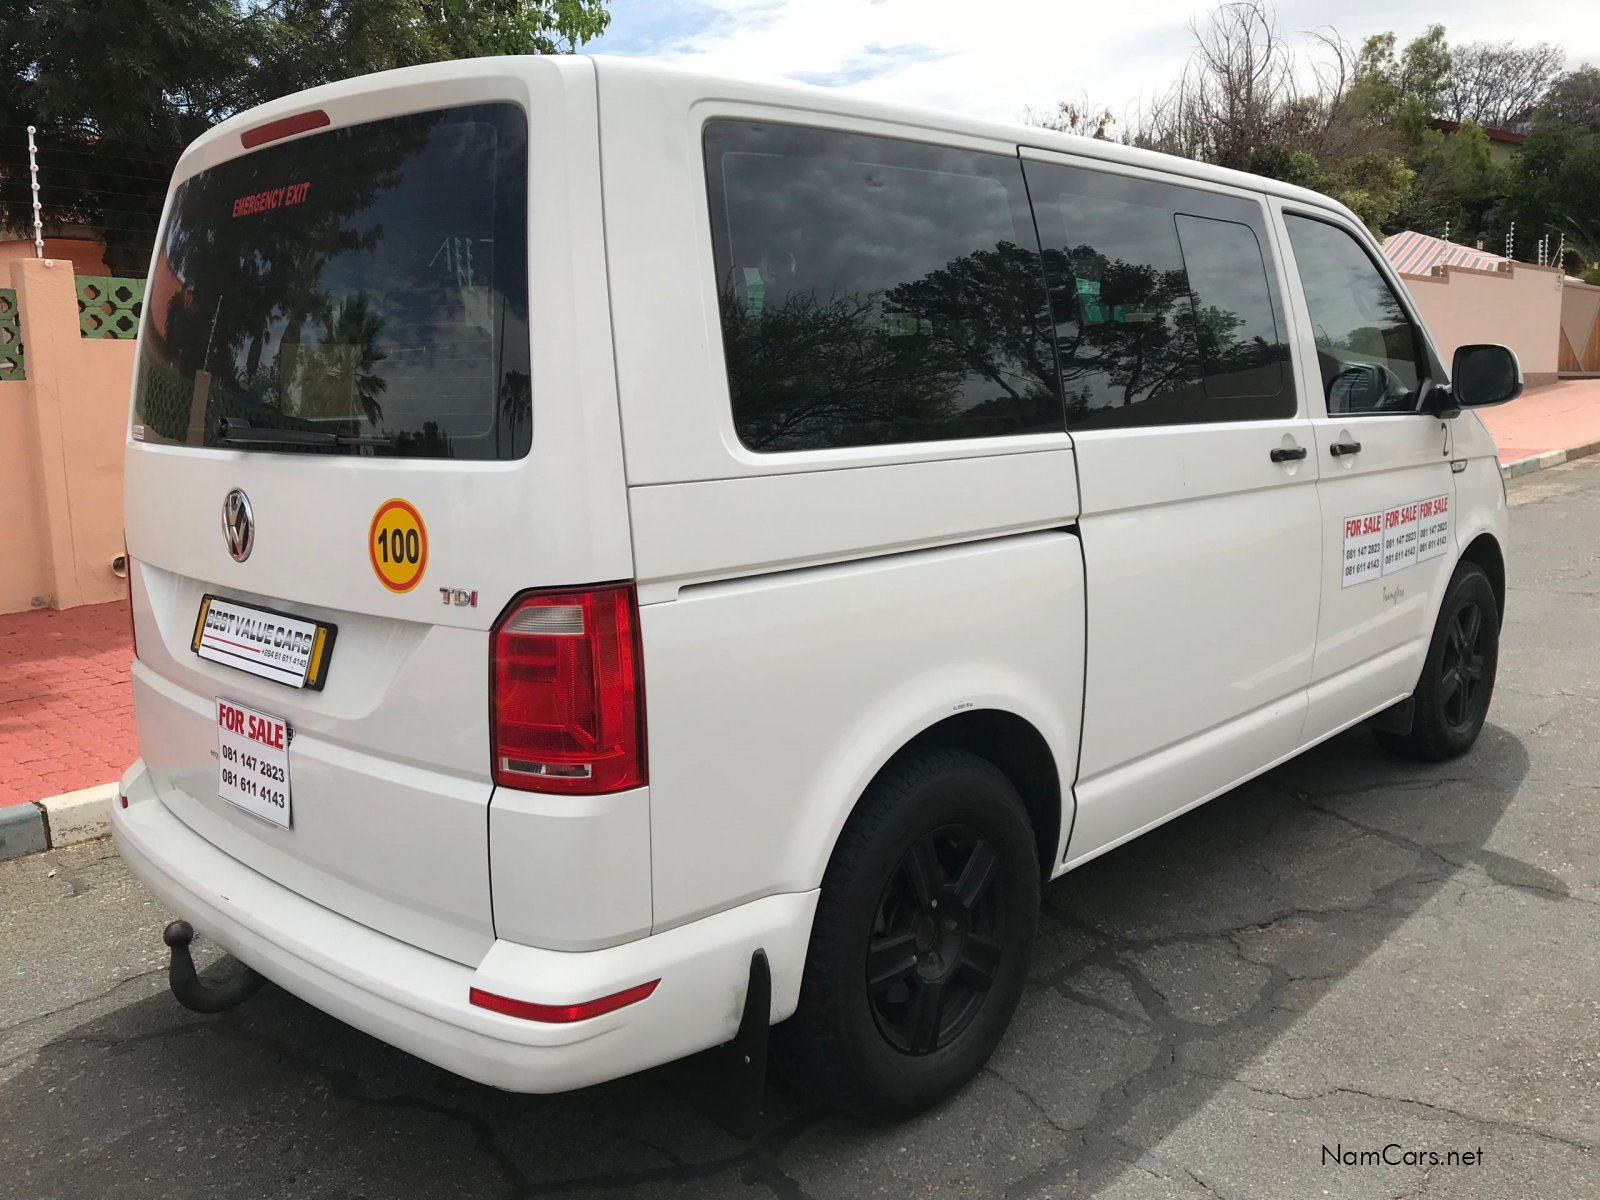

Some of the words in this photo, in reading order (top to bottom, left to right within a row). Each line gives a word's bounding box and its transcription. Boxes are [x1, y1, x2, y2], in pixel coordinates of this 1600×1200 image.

[232, 187, 286, 218] EMERGENCY
[285, 182, 310, 206] EXIT
[1385, 510, 1400, 529] FOR
[1400, 505, 1417, 525] SALE
[1420, 501, 1433, 519] FOR
[1433, 497, 1448, 515] SALE
[1345, 520, 1361, 538] FOR
[1363, 515, 1381, 535] SALE
[1420, 528, 1429, 538] 081
[1429, 524, 1437, 535] 147
[378, 528, 419, 564] 100
[1346, 549, 1356, 560] 081
[1357, 546, 1367, 557] 147
[1368, 542, 1381, 555] 2823
[1385, 537, 1395, 550] 081
[1396, 535, 1405, 546] 147
[1419, 542, 1428, 553] 081
[1428, 539, 1436, 550] 611
[1436, 536, 1447, 547] 4143
[1384, 553, 1394, 565] 081
[1394, 550, 1404, 561] 611
[1404, 546, 1416, 558] 4143
[1345, 565, 1355, 577] 081
[1356, 562, 1366, 574] 611
[1367, 558, 1380, 570] 4143
[439, 587, 478, 608] TDI
[205, 608, 236, 634] BEST
[233, 615, 275, 645] VALUE
[273, 626, 313, 655] CARS
[261, 649, 274, 659] +264
[274, 652, 281, 661] 81
[281, 655, 292, 664] 611
[292, 657, 307, 668] 4143
[218, 702, 245, 736] FOR
[247, 714, 284, 750] SALE
[222, 744, 238, 763] 081
[240, 752, 257, 771] 147
[260, 761, 285, 783] 2823
[222, 768, 238, 788] 081
[240, 777, 257, 797] 611
[259, 786, 285, 809] 4143
